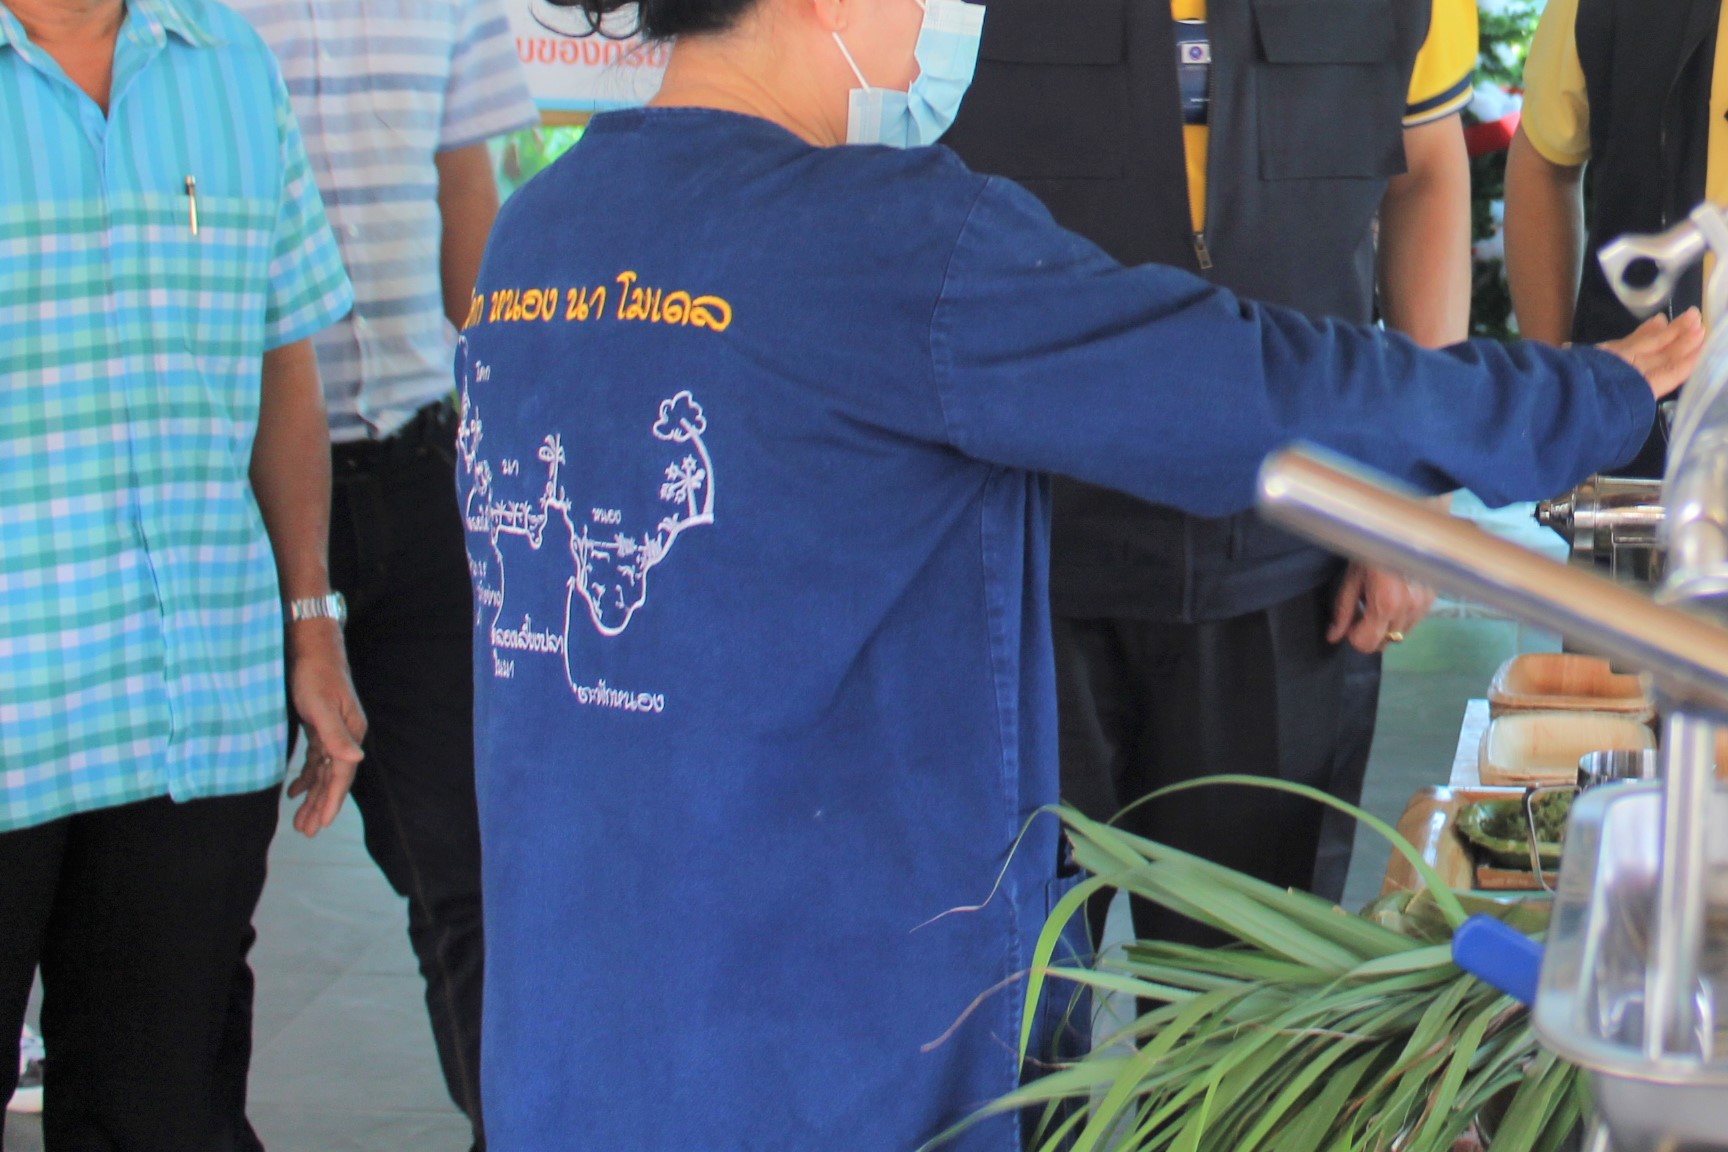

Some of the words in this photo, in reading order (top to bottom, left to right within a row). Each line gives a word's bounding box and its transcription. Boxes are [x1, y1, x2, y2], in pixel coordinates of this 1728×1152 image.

[489, 286, 559, 323] หนอง
[566, 285, 606, 322] นา
[616, 270, 732, 332] โมเดล
